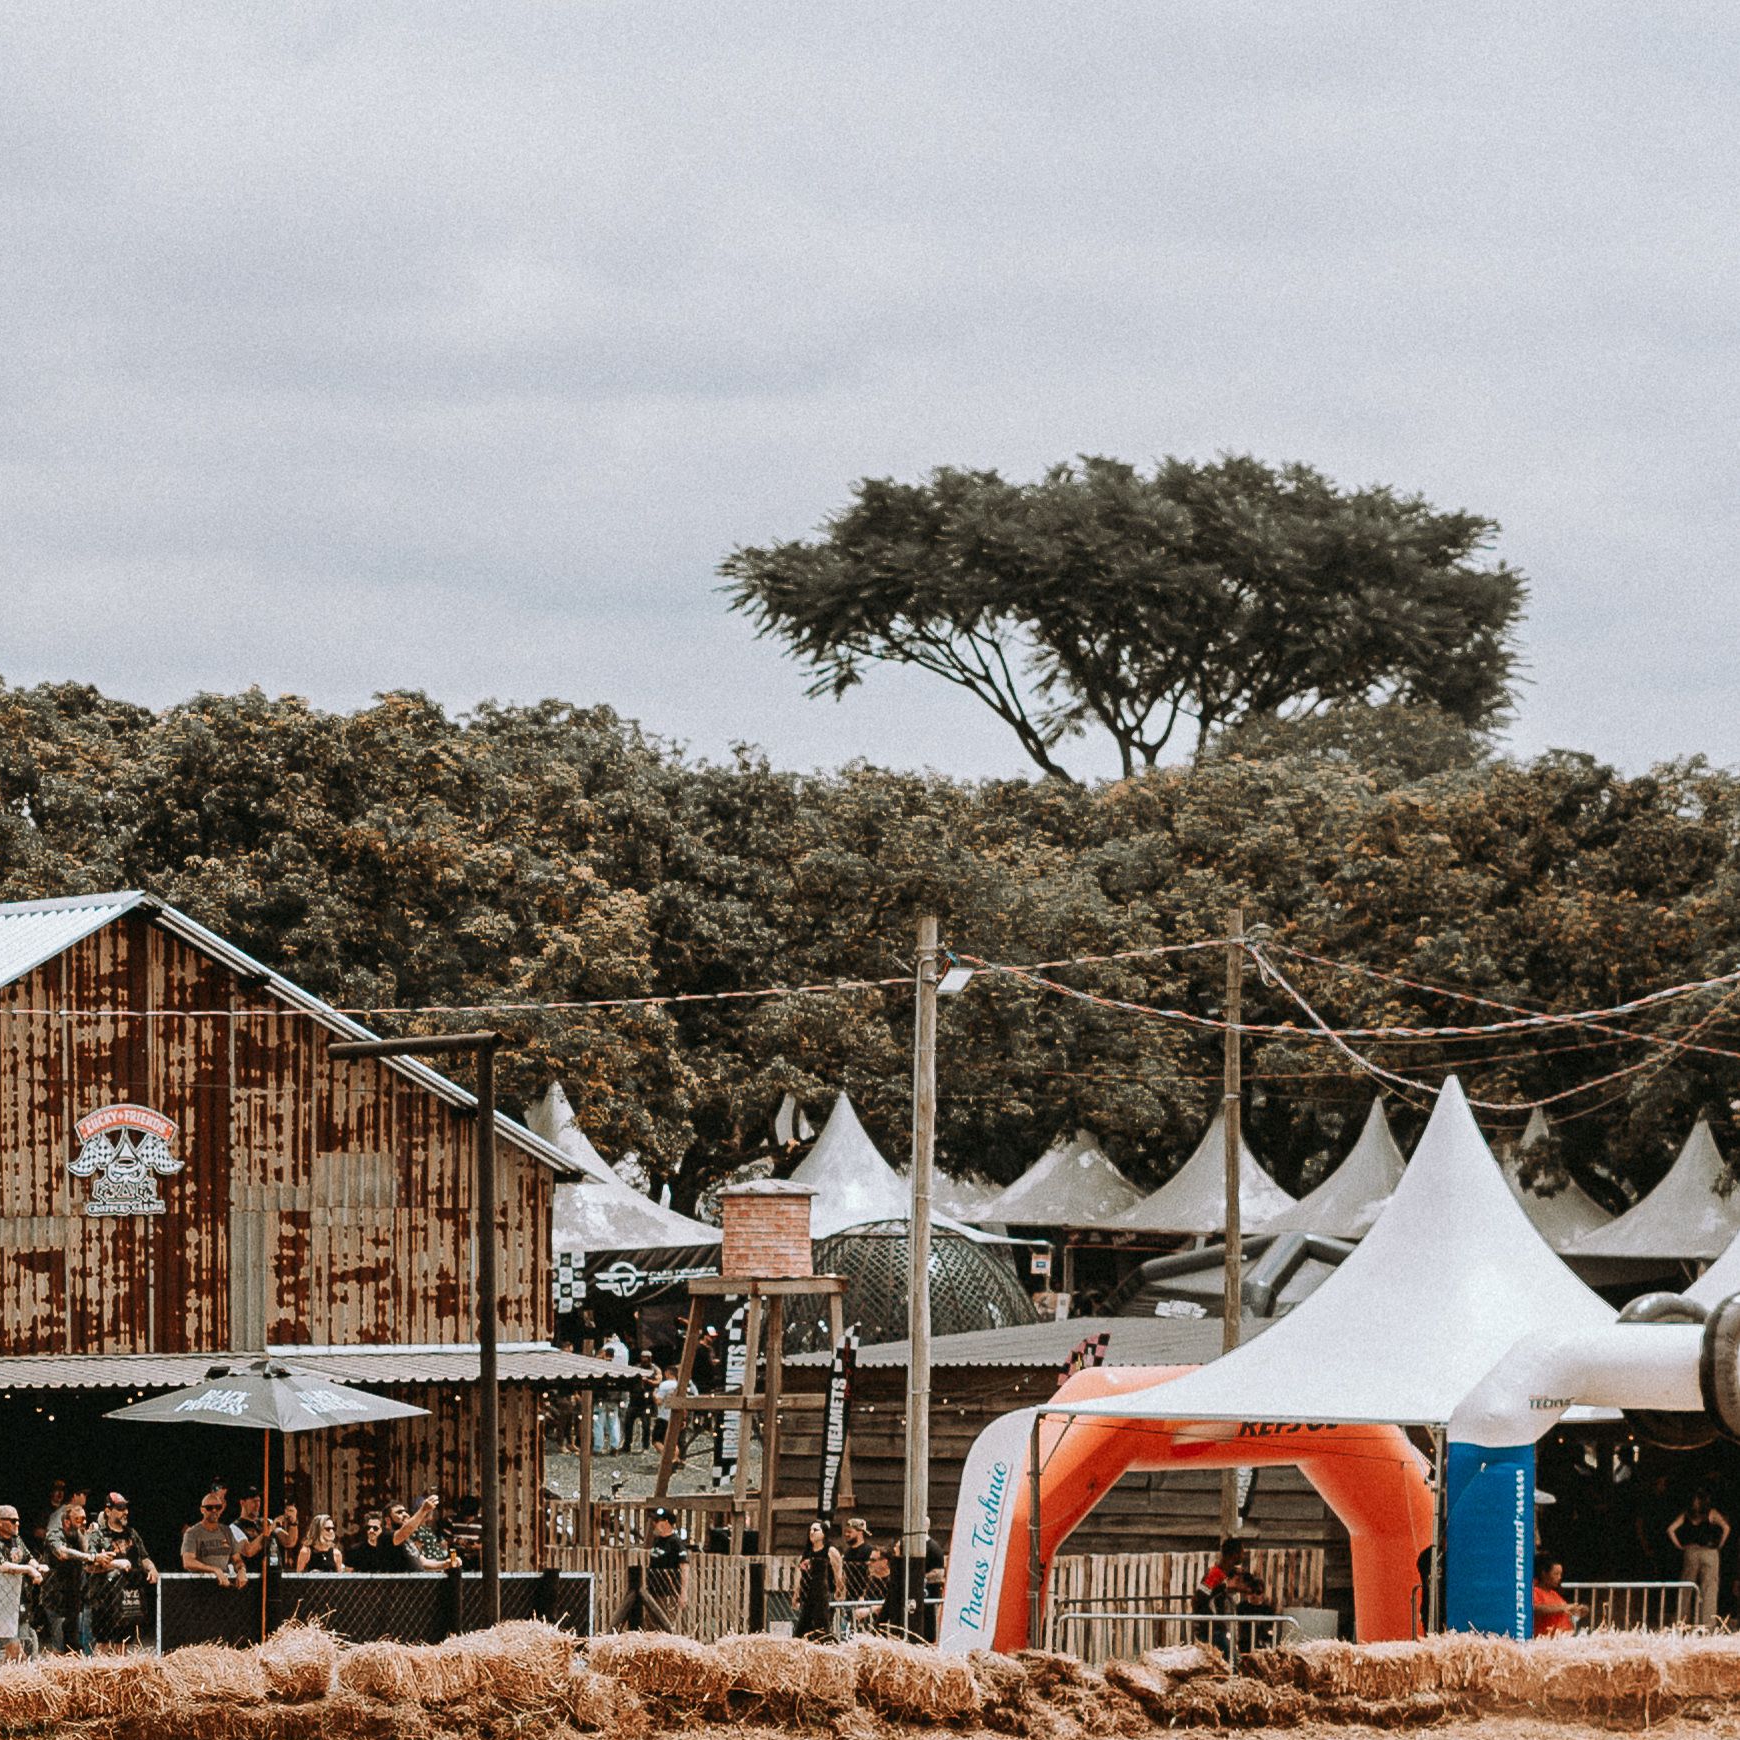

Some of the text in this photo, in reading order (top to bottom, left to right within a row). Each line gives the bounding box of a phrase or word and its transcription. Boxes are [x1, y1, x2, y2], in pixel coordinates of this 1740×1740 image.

[822, 1377, 847, 1512] URBAN HELMETS
[958, 1460, 1008, 1631] Pneus Technic
